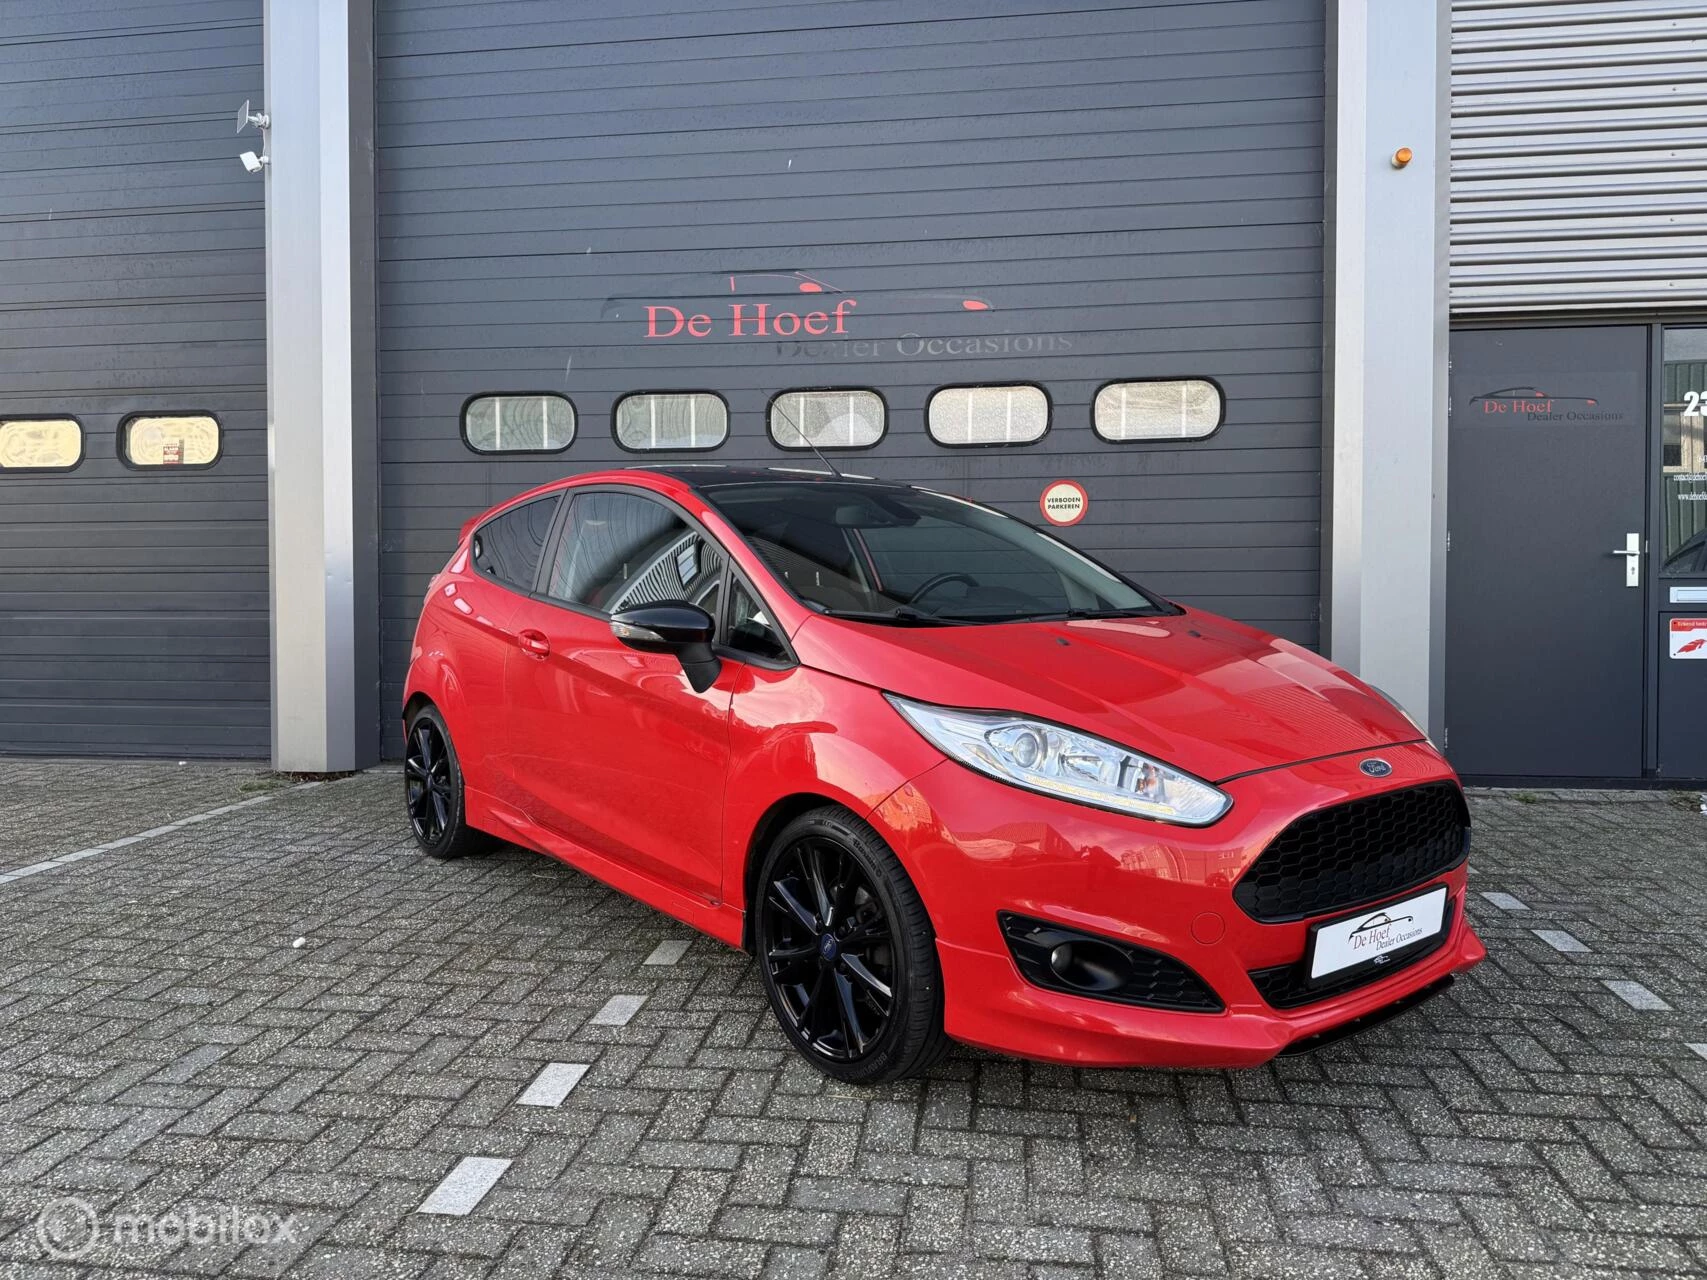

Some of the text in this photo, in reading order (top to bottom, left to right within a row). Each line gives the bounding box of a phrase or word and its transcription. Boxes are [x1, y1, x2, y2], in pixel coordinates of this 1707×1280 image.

[643, 299, 857, 338] De Hoef
[897, 330, 1073, 357] Occasions
[1484, 399, 1554, 413] De Hoef
[1527, 411, 1623, 421] Dealer Occasions
[1353, 923, 1392, 950] De Hoef
[1376, 928, 1423, 951] Dealer Occasions
